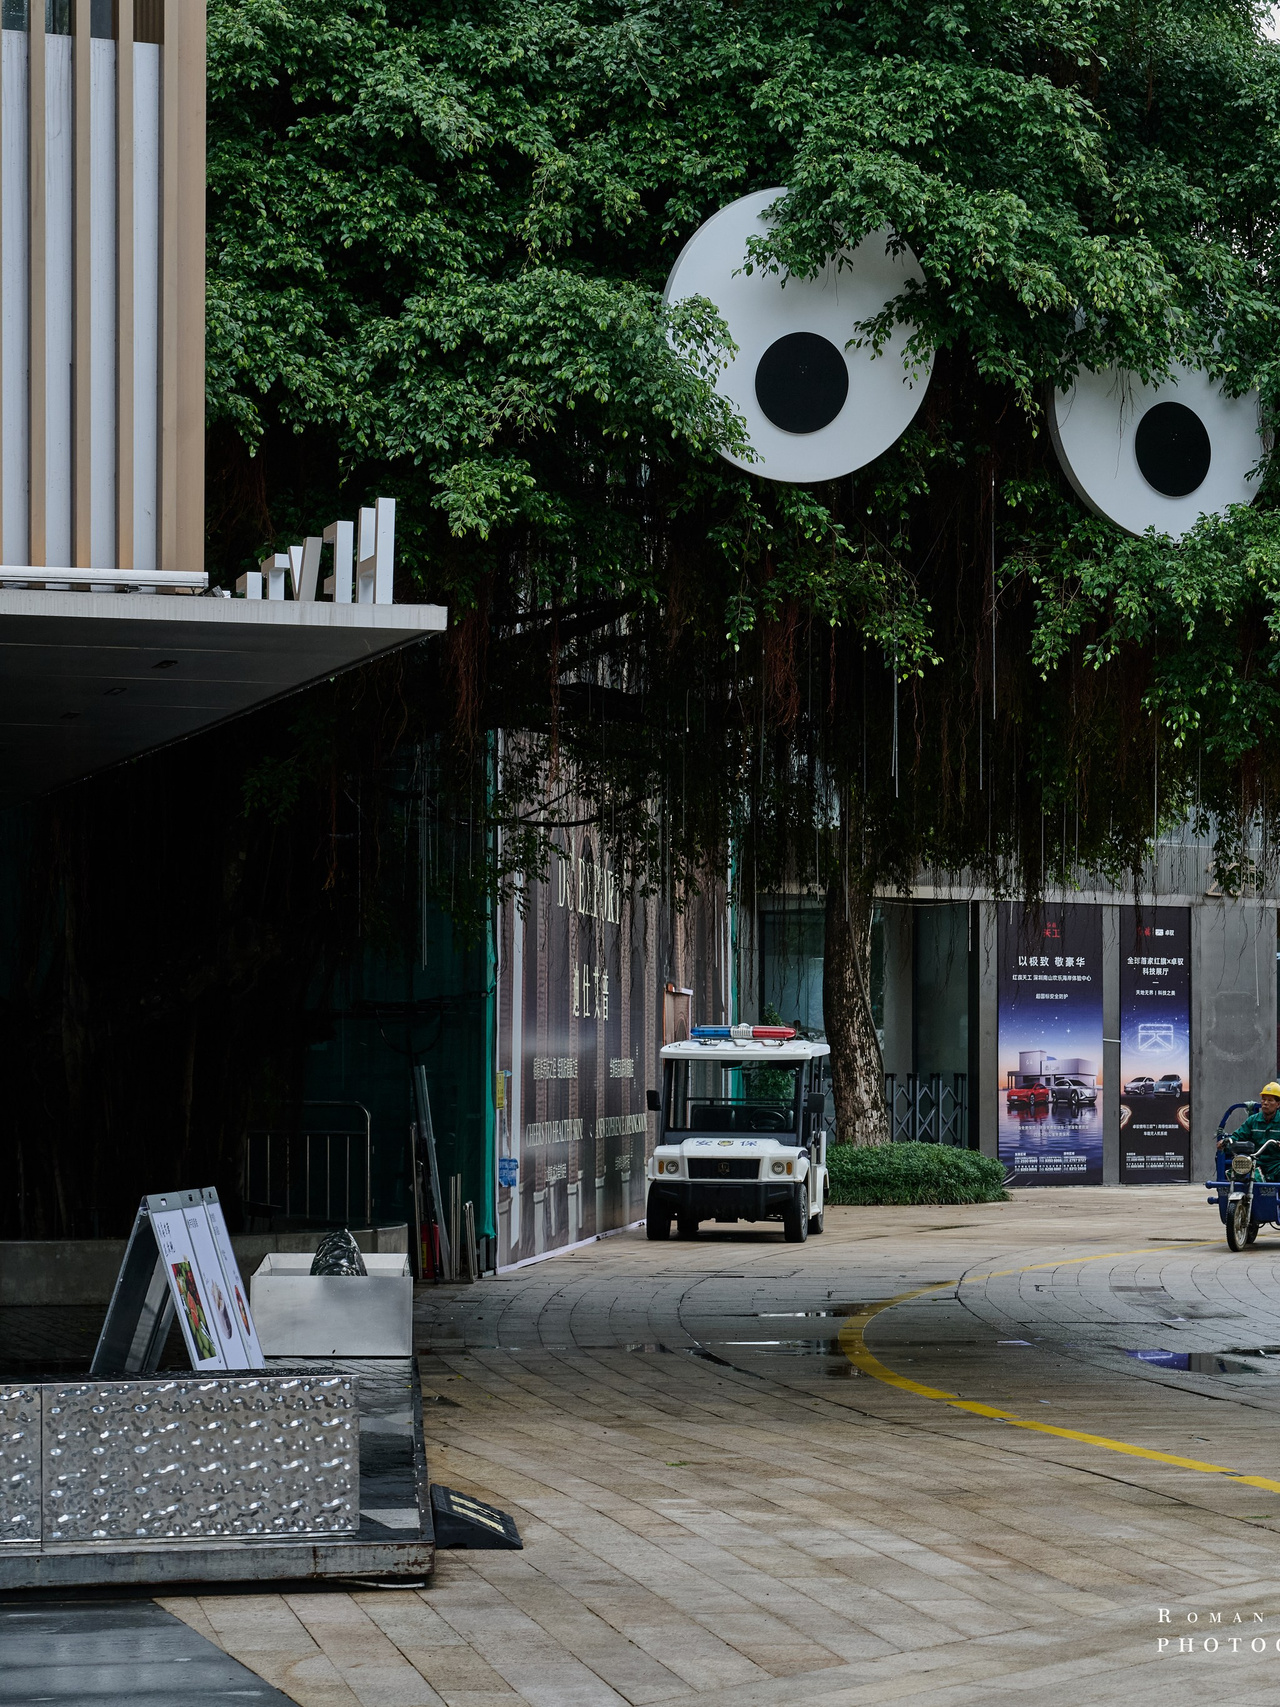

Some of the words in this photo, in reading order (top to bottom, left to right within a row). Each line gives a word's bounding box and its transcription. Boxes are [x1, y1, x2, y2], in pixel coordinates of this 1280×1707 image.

[1018, 956, 1050, 967] 以极致
[1054, 956, 1086, 968] 敬豪华
[1142, 967, 1169, 976] 科技展厅
